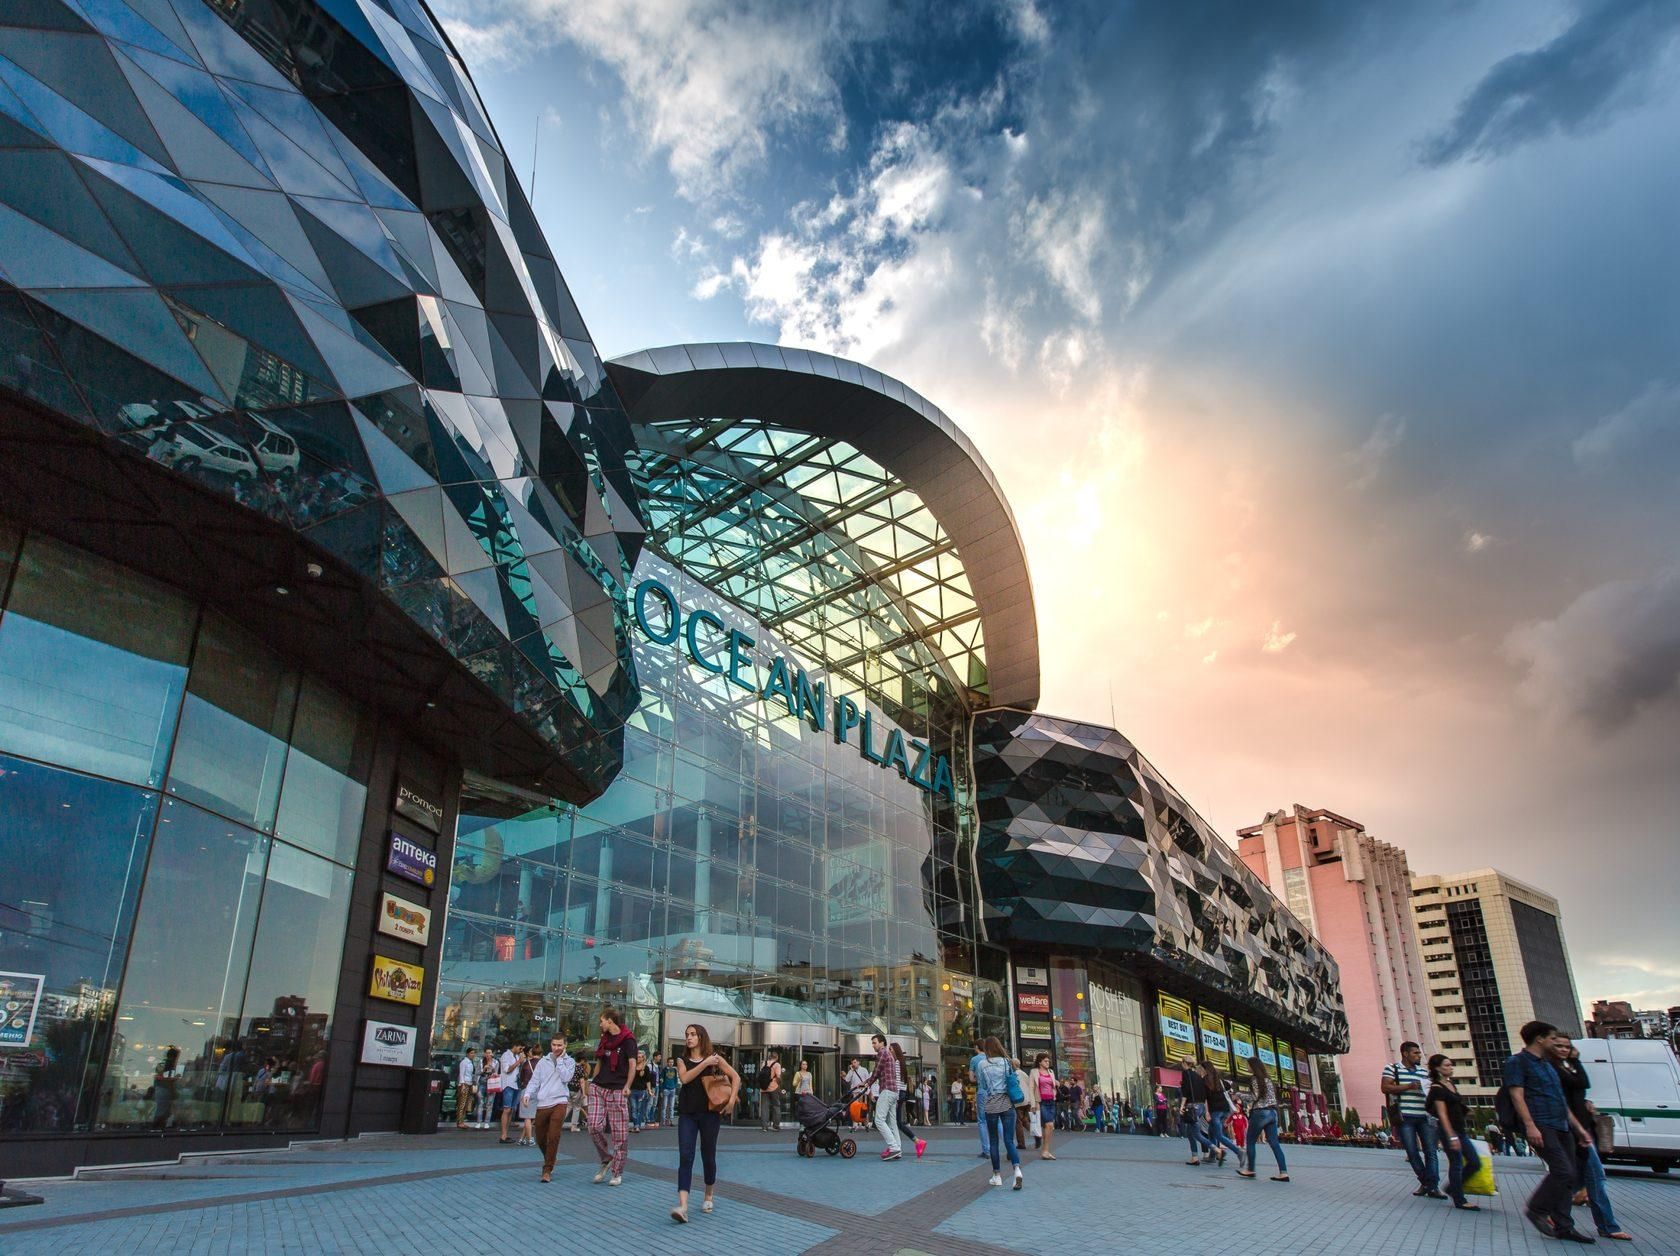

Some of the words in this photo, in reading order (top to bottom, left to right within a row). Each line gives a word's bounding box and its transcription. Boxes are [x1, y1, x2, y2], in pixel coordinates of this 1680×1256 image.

[634, 579, 824, 731] OCEAN
[836, 695, 955, 801] PLAZA
[400, 787, 442, 817] promod
[393, 837, 436, 868] аптека
[1019, 996, 1048, 1006] welfare
[1088, 981, 1131, 1014] ROSHEN
[375, 1028, 407, 1043] ZARINA
[1167, 1019, 1178, 1030] BEST
